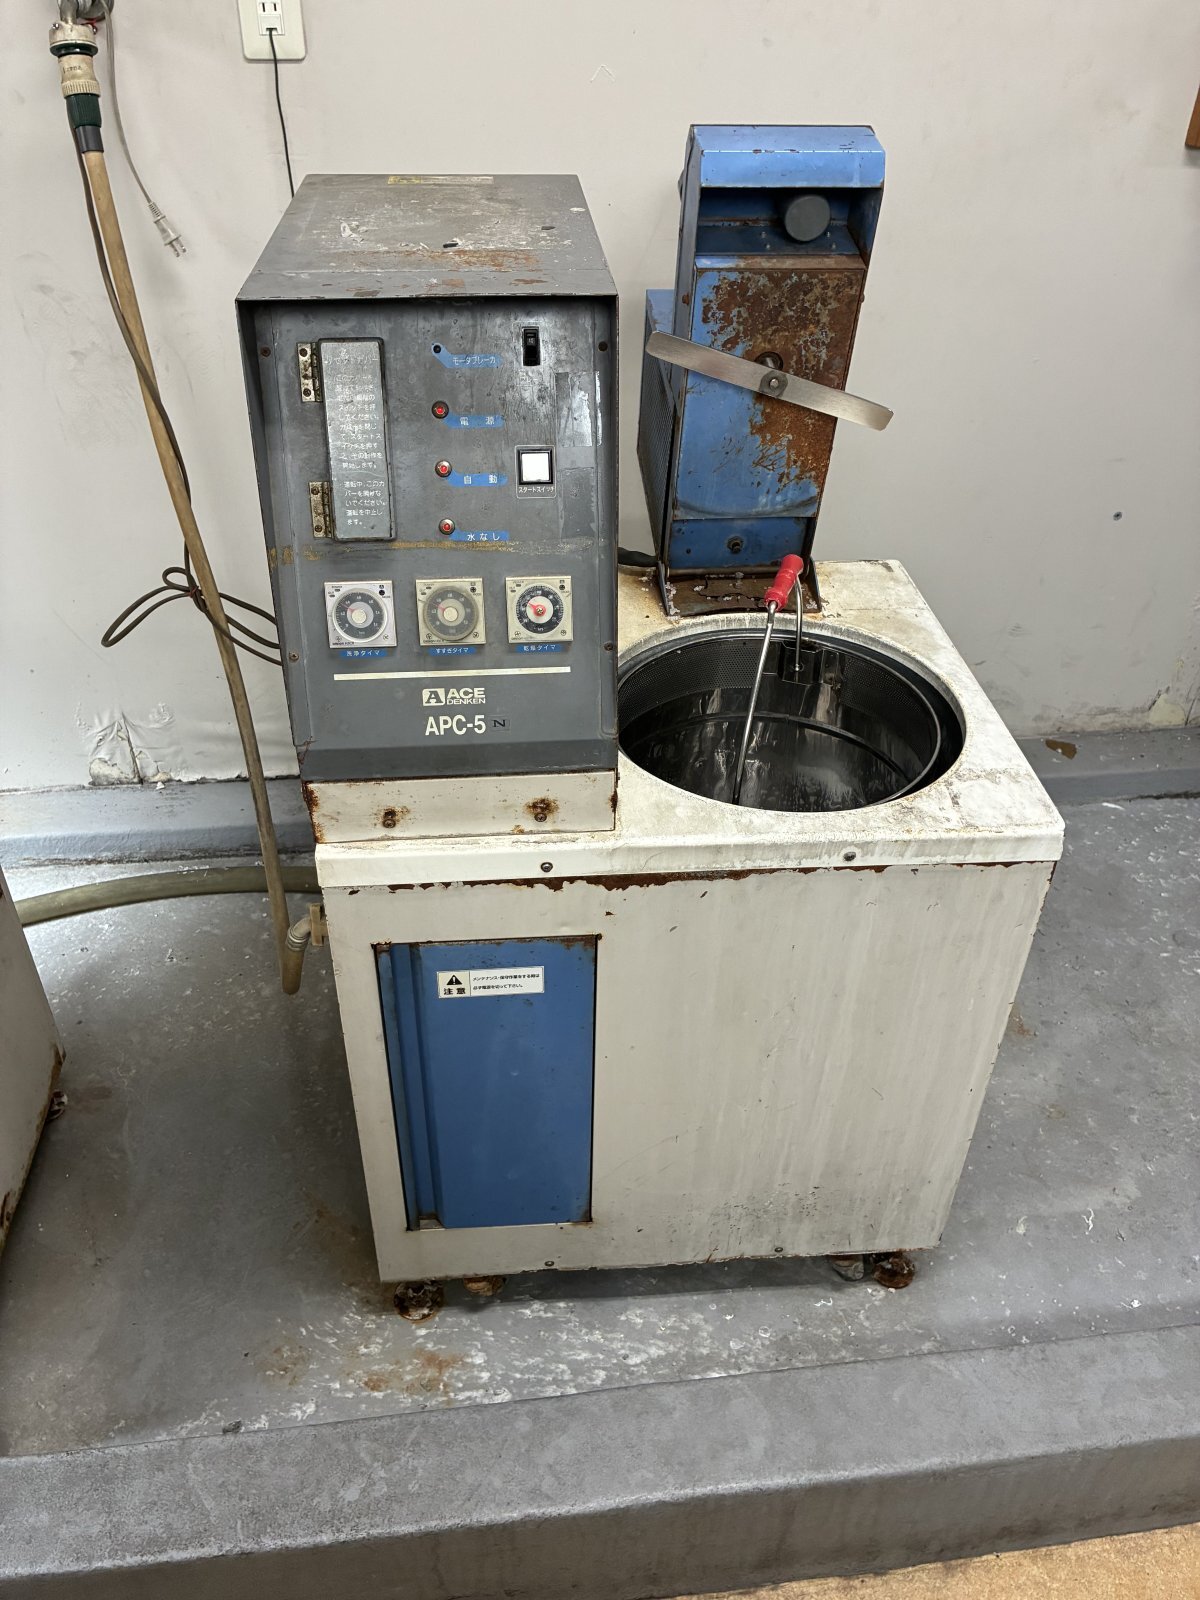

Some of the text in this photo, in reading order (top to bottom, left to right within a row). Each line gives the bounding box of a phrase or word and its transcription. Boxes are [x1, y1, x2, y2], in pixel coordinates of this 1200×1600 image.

[452, 357, 496, 365] モータブレーカ
[467, 532, 500, 541] 水なし
[447, 687, 486, 699] ACE
[425, 714, 506, 736] APC-5 N
[443, 987, 466, 996] 注意
